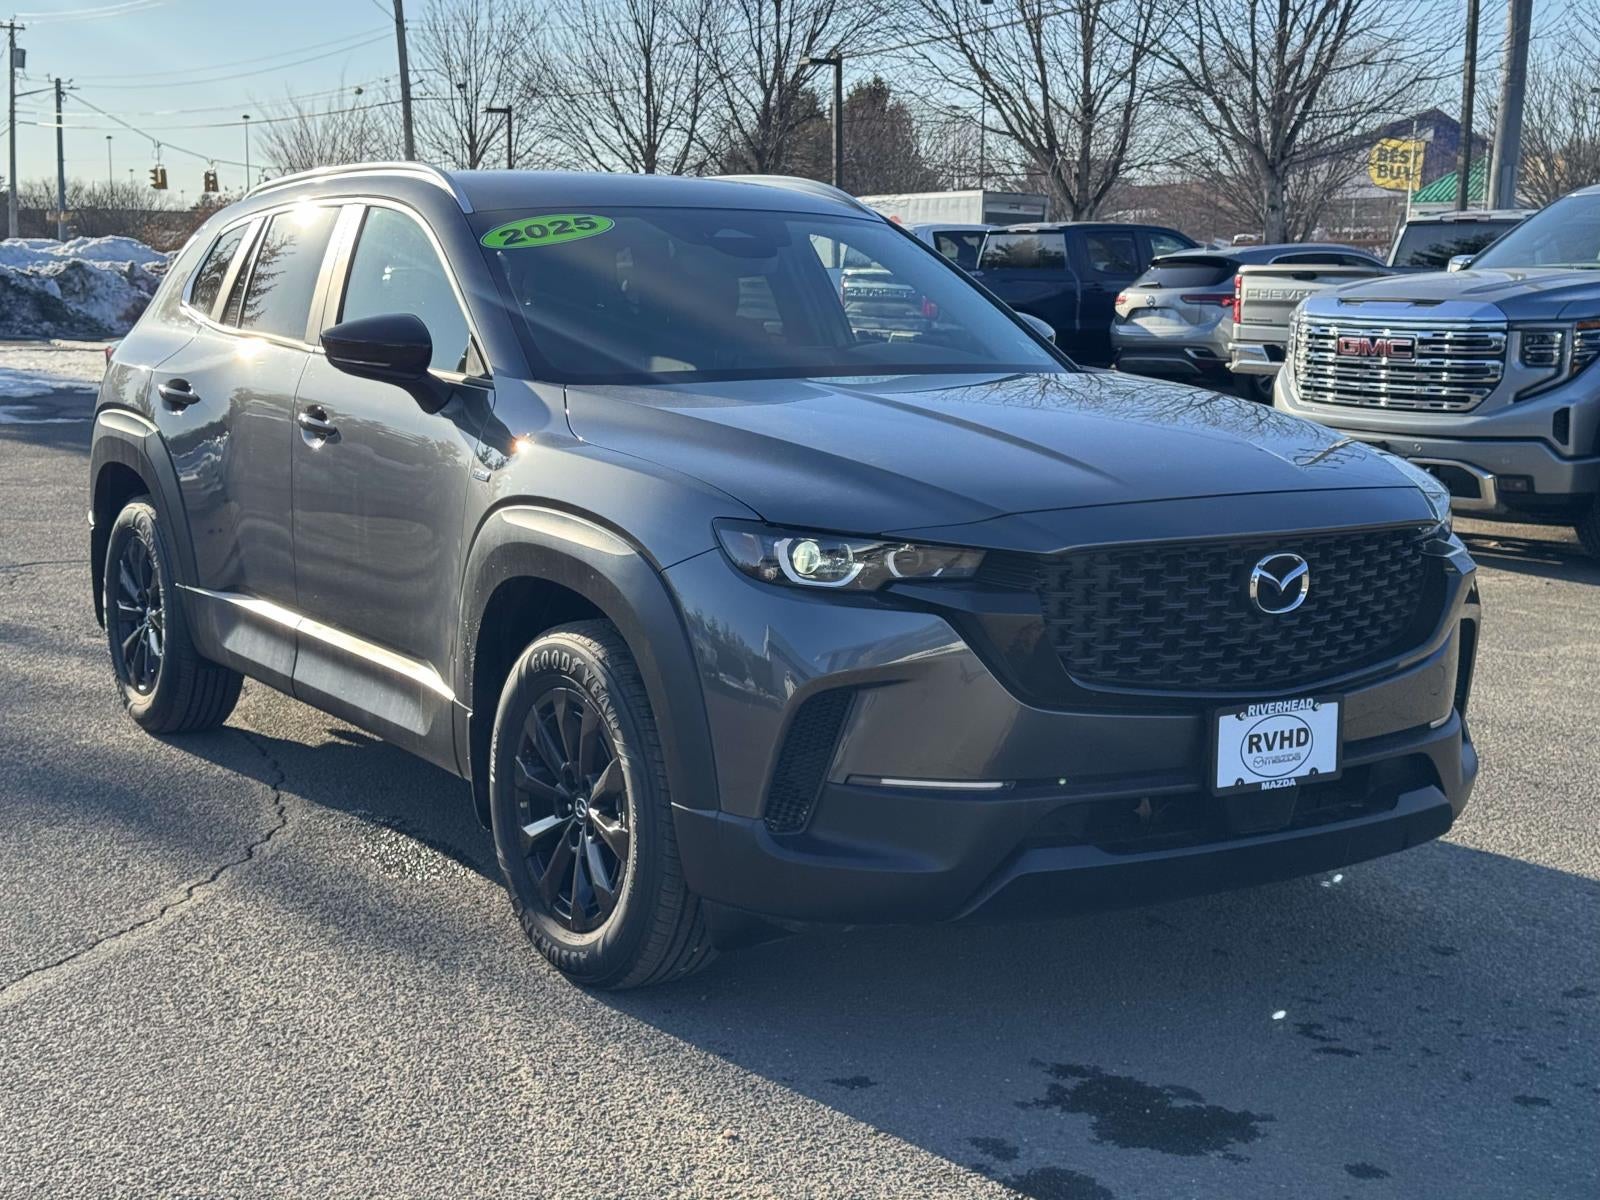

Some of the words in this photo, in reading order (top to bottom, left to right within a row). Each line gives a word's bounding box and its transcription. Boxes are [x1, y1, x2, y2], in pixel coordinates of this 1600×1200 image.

[1377, 147, 1421, 163] BEST
[1377, 164, 1415, 180] BUY
[499, 217, 598, 245] 2025
[1338, 336, 1412, 358] GMC
[1248, 698, 1314, 716] RIVERHEAD
[1248, 727, 1310, 754] RVHD
[1261, 778, 1296, 791] MAZDA
